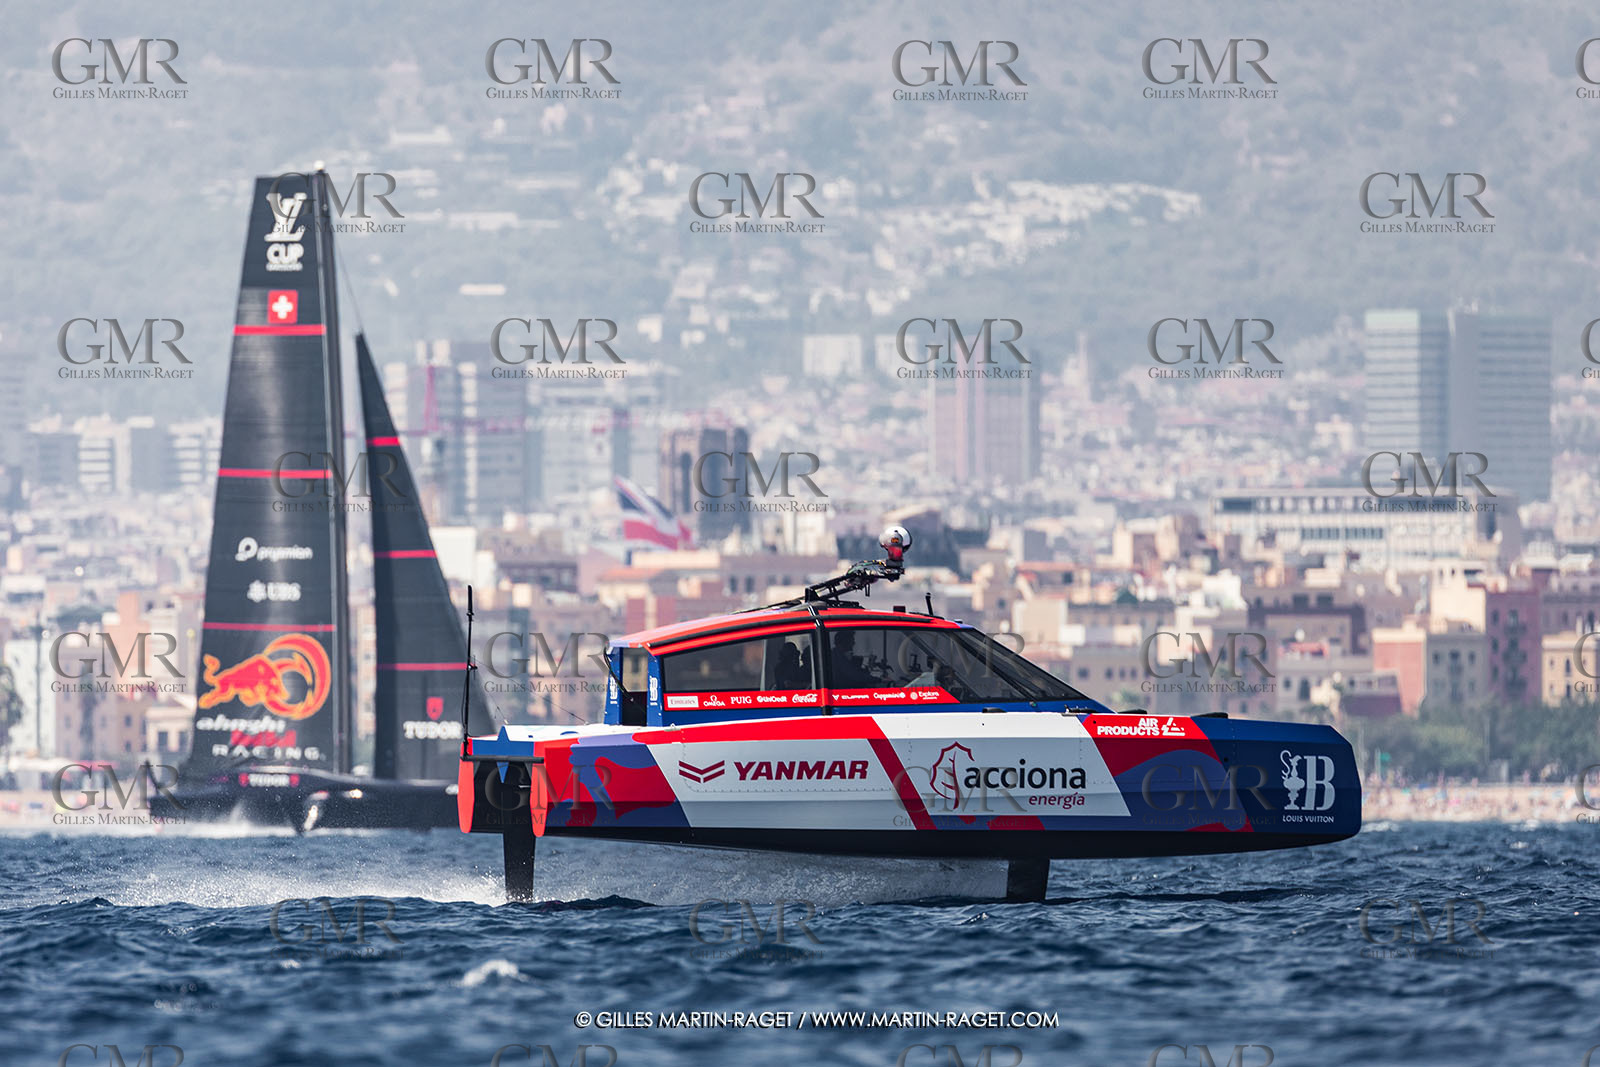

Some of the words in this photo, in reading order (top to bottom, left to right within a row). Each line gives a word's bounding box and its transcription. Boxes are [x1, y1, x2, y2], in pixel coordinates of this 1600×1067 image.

[730, 696, 752, 705] PUIG
[1138, 718, 1158, 727] AIR
[403, 721, 463, 739] TUDOR
[1097, 726, 1160, 736] PRODUCTS
[733, 760, 869, 781] YANMAR
[963, 758, 1087, 789] acciona
[1028, 792, 1086, 810] energía
[1282, 815, 1304, 823] LOUIS
[1305, 815, 1335, 823] VUITTON
